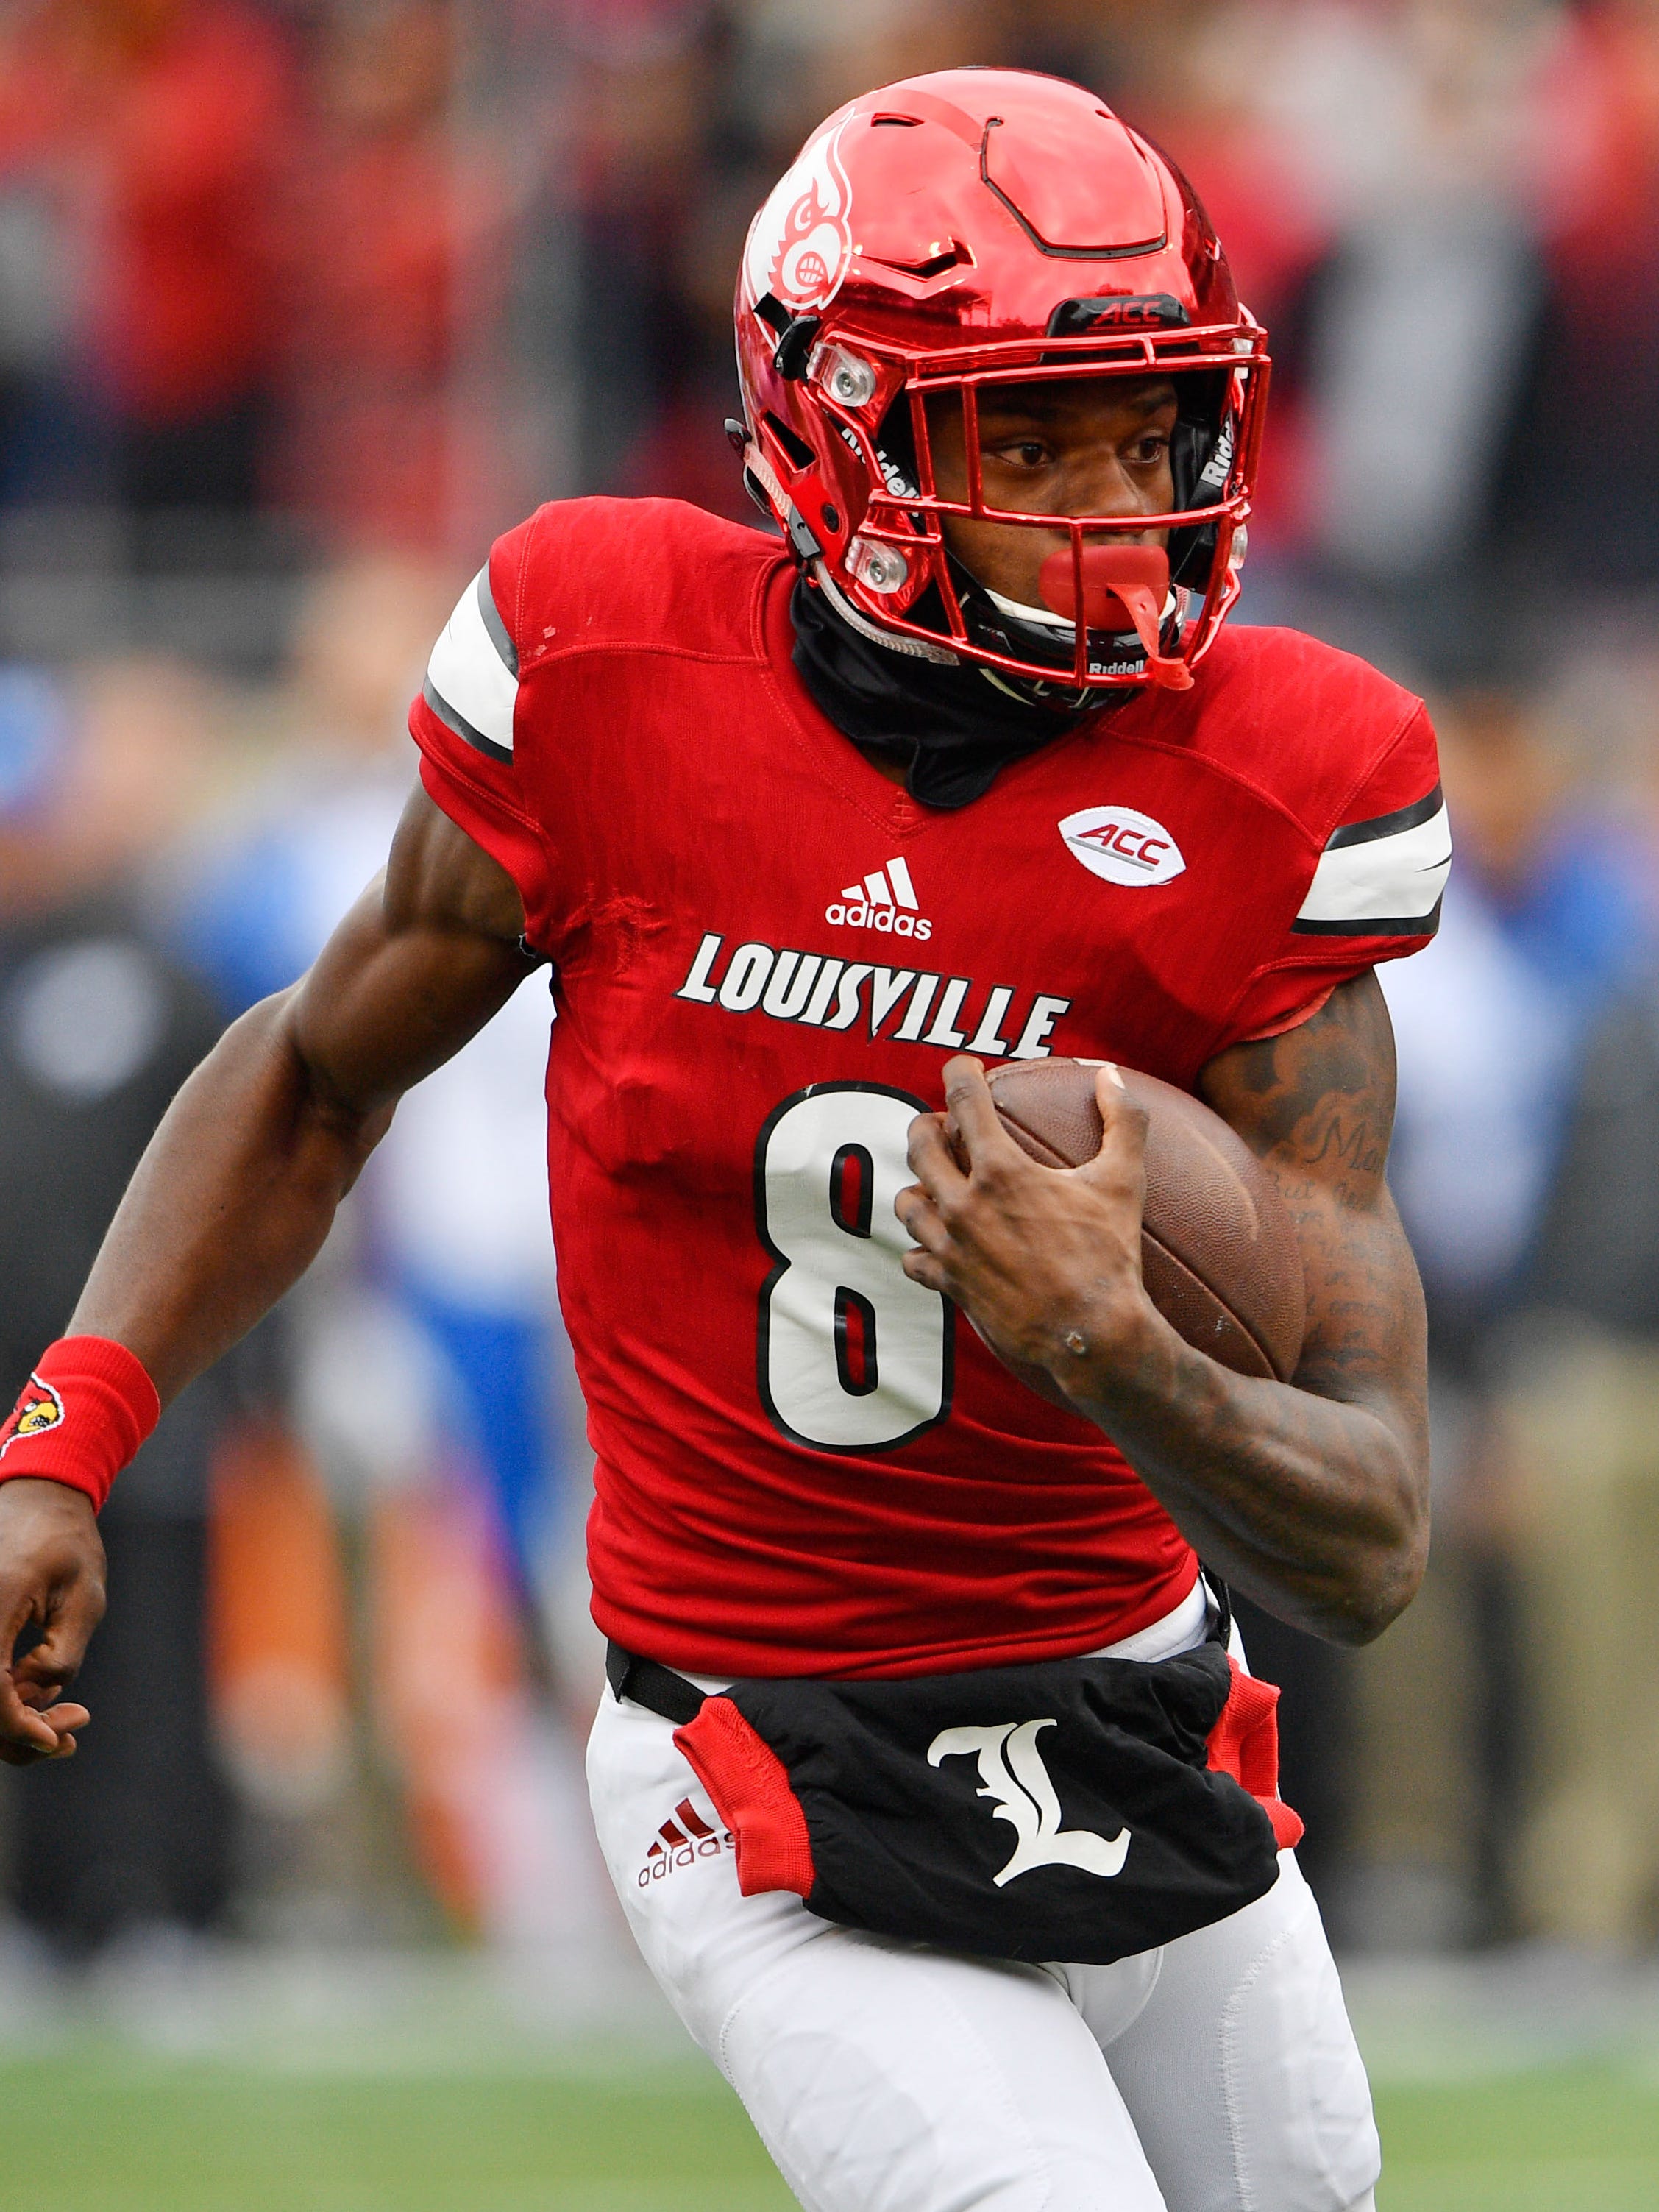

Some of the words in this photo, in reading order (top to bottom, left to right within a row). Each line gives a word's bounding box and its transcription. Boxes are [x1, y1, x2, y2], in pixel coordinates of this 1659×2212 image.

[1093, 302, 1162, 324] ACC
[1090, 659, 1144, 675] Riddell
[1078, 823, 1170, 865] ACC
[825, 900, 933, 940] adidas
[676, 931, 1074, 1059] LOUISVILLE
[754, 1080, 955, 1454] 8
[927, 1718, 1132, 1888] L
